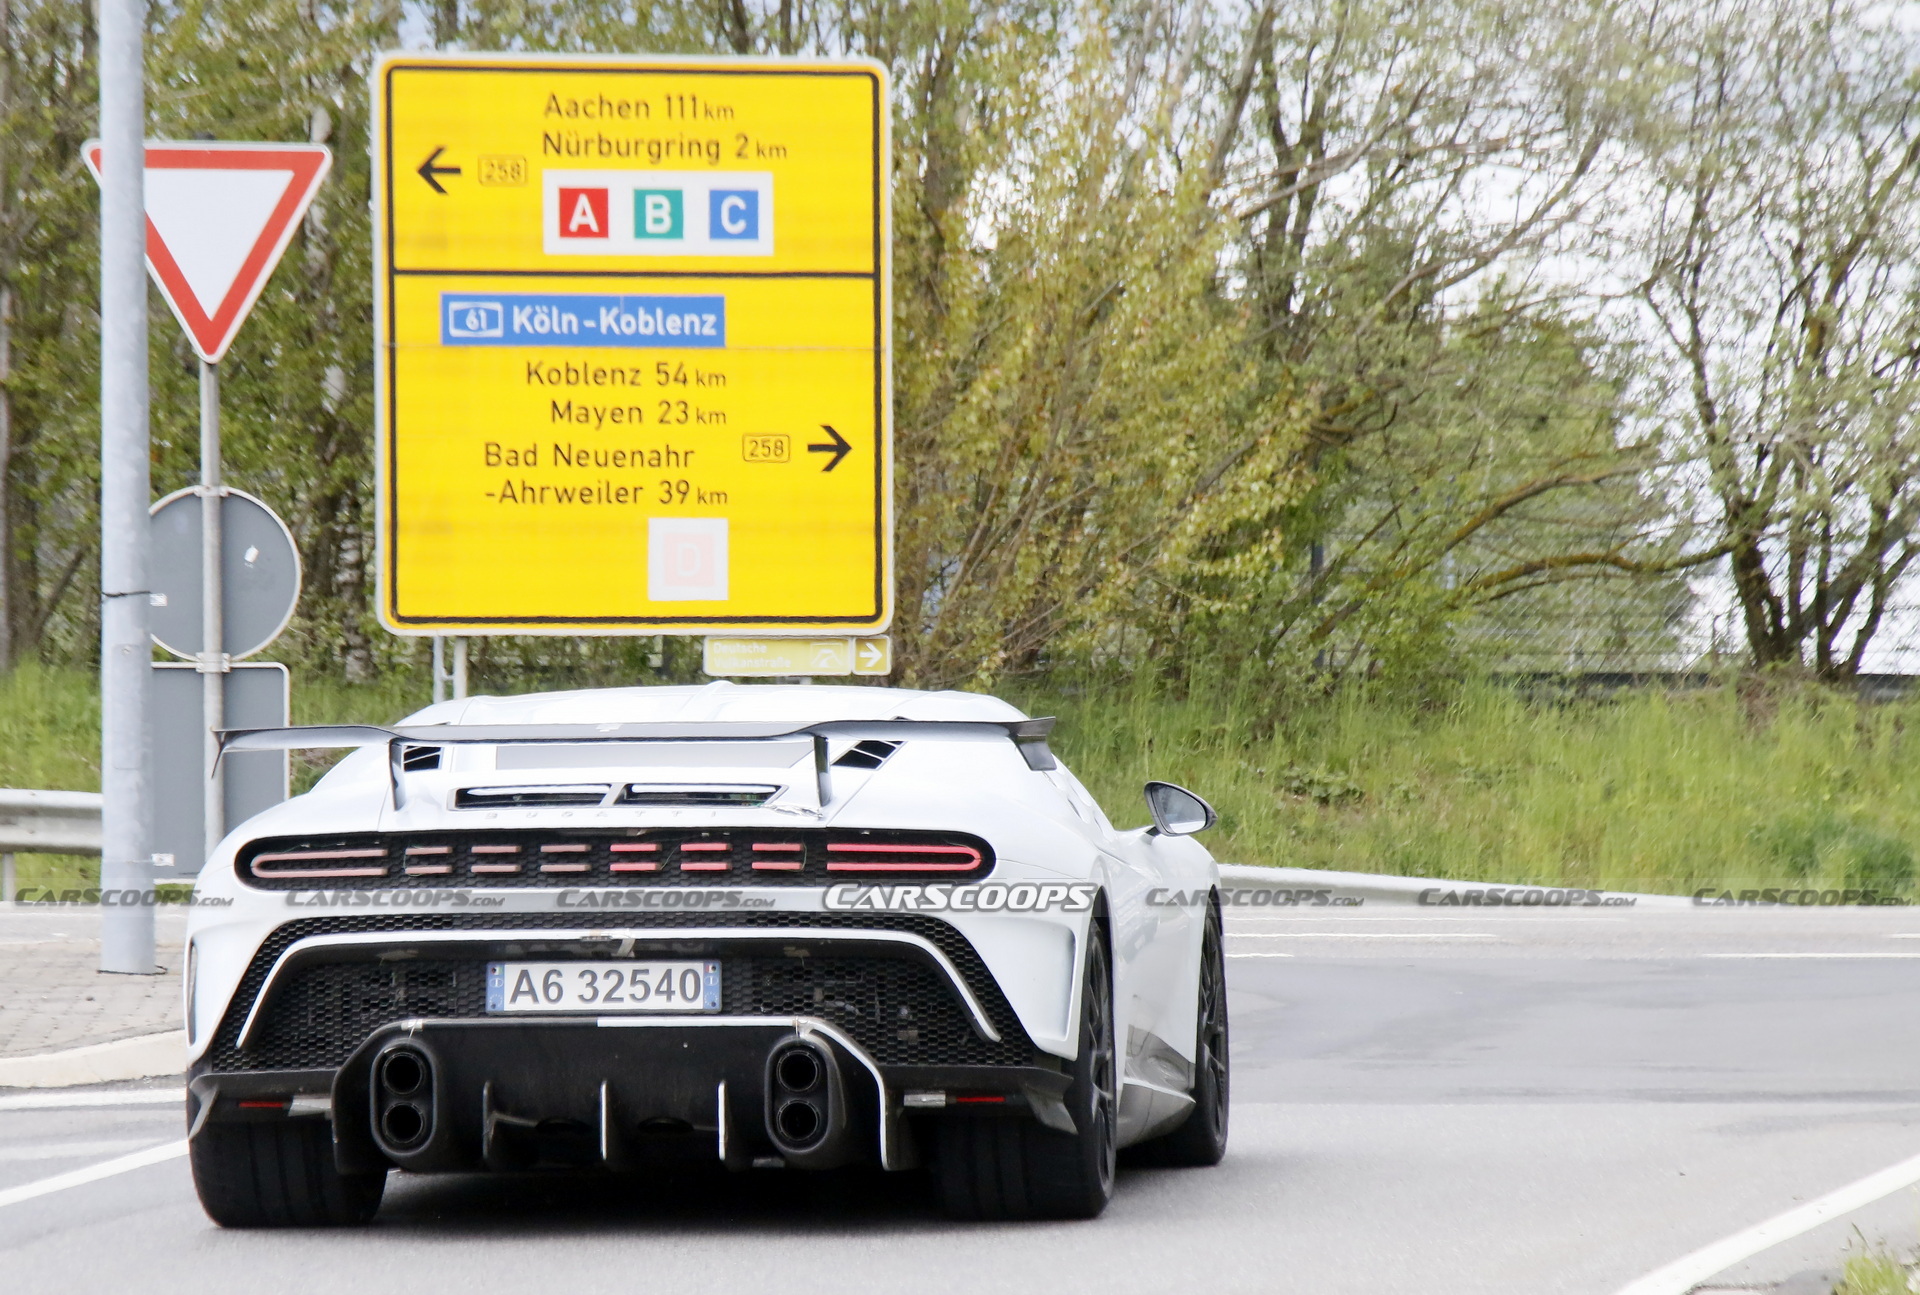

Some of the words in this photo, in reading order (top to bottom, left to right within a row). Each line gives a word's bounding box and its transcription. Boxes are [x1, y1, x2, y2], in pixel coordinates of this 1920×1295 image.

[543, 92, 650, 120] Aachen
[665, 93, 698, 120] 111
[703, 99, 735, 121] km
[542, 130, 721, 165] Nürburgring
[735, 132, 749, 160] 2
[756, 139, 787, 160] km
[483, 162, 522, 181] 258
[567, 193, 600, 233] A
[644, 195, 673, 234] B
[720, 196, 748, 235] C
[465, 308, 488, 331] 61
[526, 360, 642, 386] Koblenz
[656, 361, 688, 387] 54
[696, 368, 727, 388] km
[550, 399, 643, 431] Mayen
[657, 400, 689, 425] 23
[696, 406, 727, 425] km
[484, 441, 538, 467] Bad
[553, 442, 695, 468] Neuenahr
[749, 438, 785, 458] 258
[484, 479, 643, 505] -Ahrweiler
[658, 479, 690, 505] 39
[697, 487, 728, 506] km
[676, 542, 698, 578] D
[509, 969, 564, 1004] A6
[577, 968, 701, 1004] 32540
